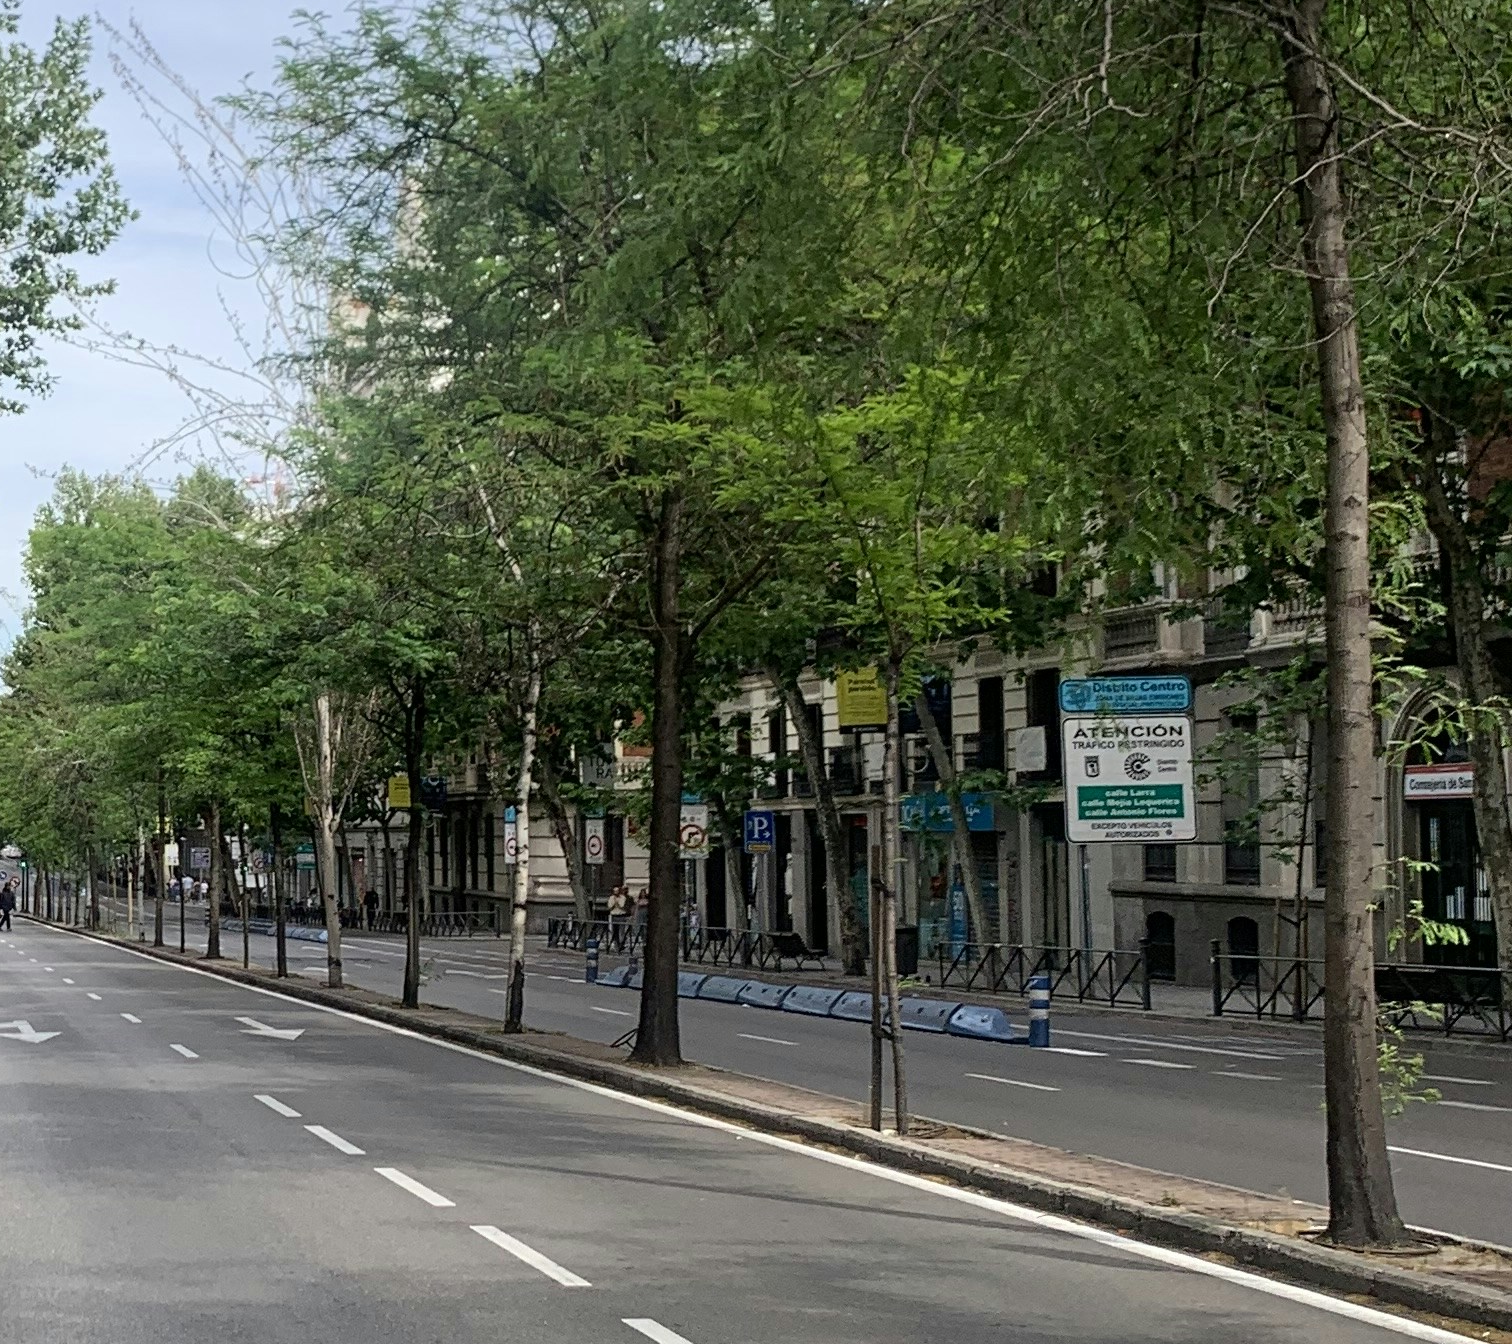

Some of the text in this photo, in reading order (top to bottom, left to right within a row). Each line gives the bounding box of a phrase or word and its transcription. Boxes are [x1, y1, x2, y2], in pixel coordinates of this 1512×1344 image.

[1139, 681, 1186, 692] Centro
[1073, 723, 1183, 739] ATENCIÓN
[1117, 739, 1185, 749] RESTRINGIDO
[1105, 788, 1156, 797] calle Larra
[1081, 799, 1105, 807] calle
[1110, 808, 1147, 816] Antonio
[1148, 807, 1178, 815] Flores
[752, 816, 768, 839] P
[1091, 822, 1127, 830] EXCEPTO
[1105, 830, 1160, 838] AUTORIZADOS
